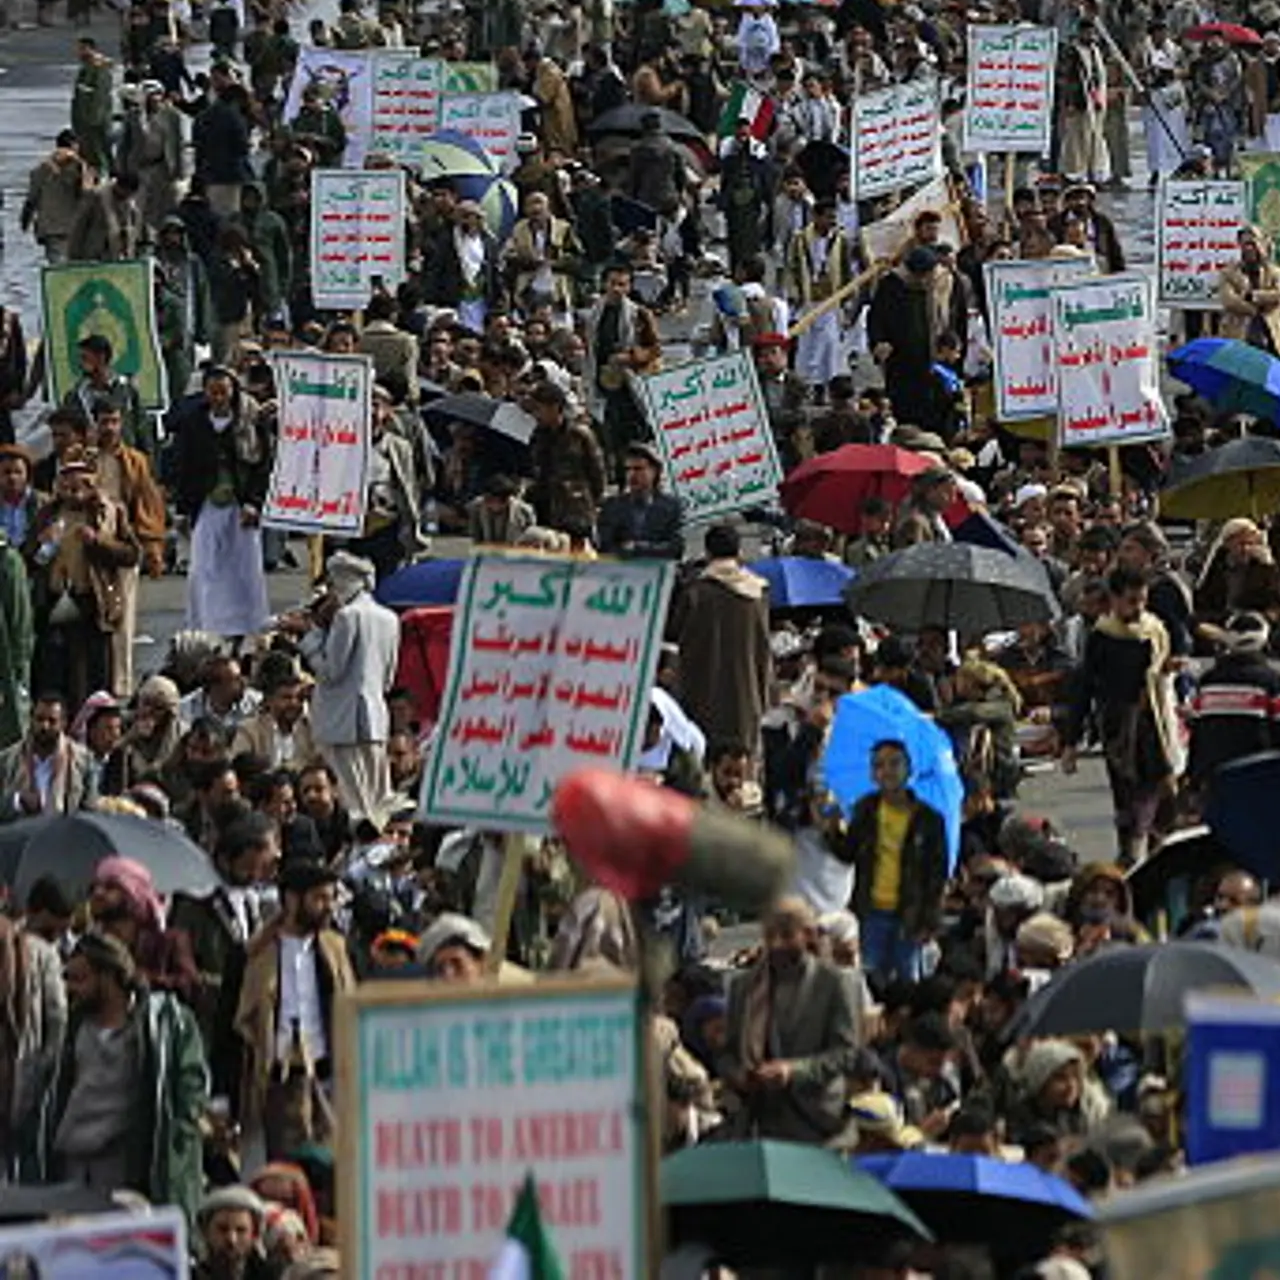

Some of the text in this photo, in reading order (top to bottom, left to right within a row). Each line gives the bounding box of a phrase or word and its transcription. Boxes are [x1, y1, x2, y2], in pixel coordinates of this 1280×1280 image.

[586, 576, 653, 614] الله
[374, 1024, 440, 1089] ALLAH
[374, 1110, 625, 1168] DEATH TO AMERICA
[376, 1184, 464, 1238] DEATH
[471, 1182, 504, 1233] TO
